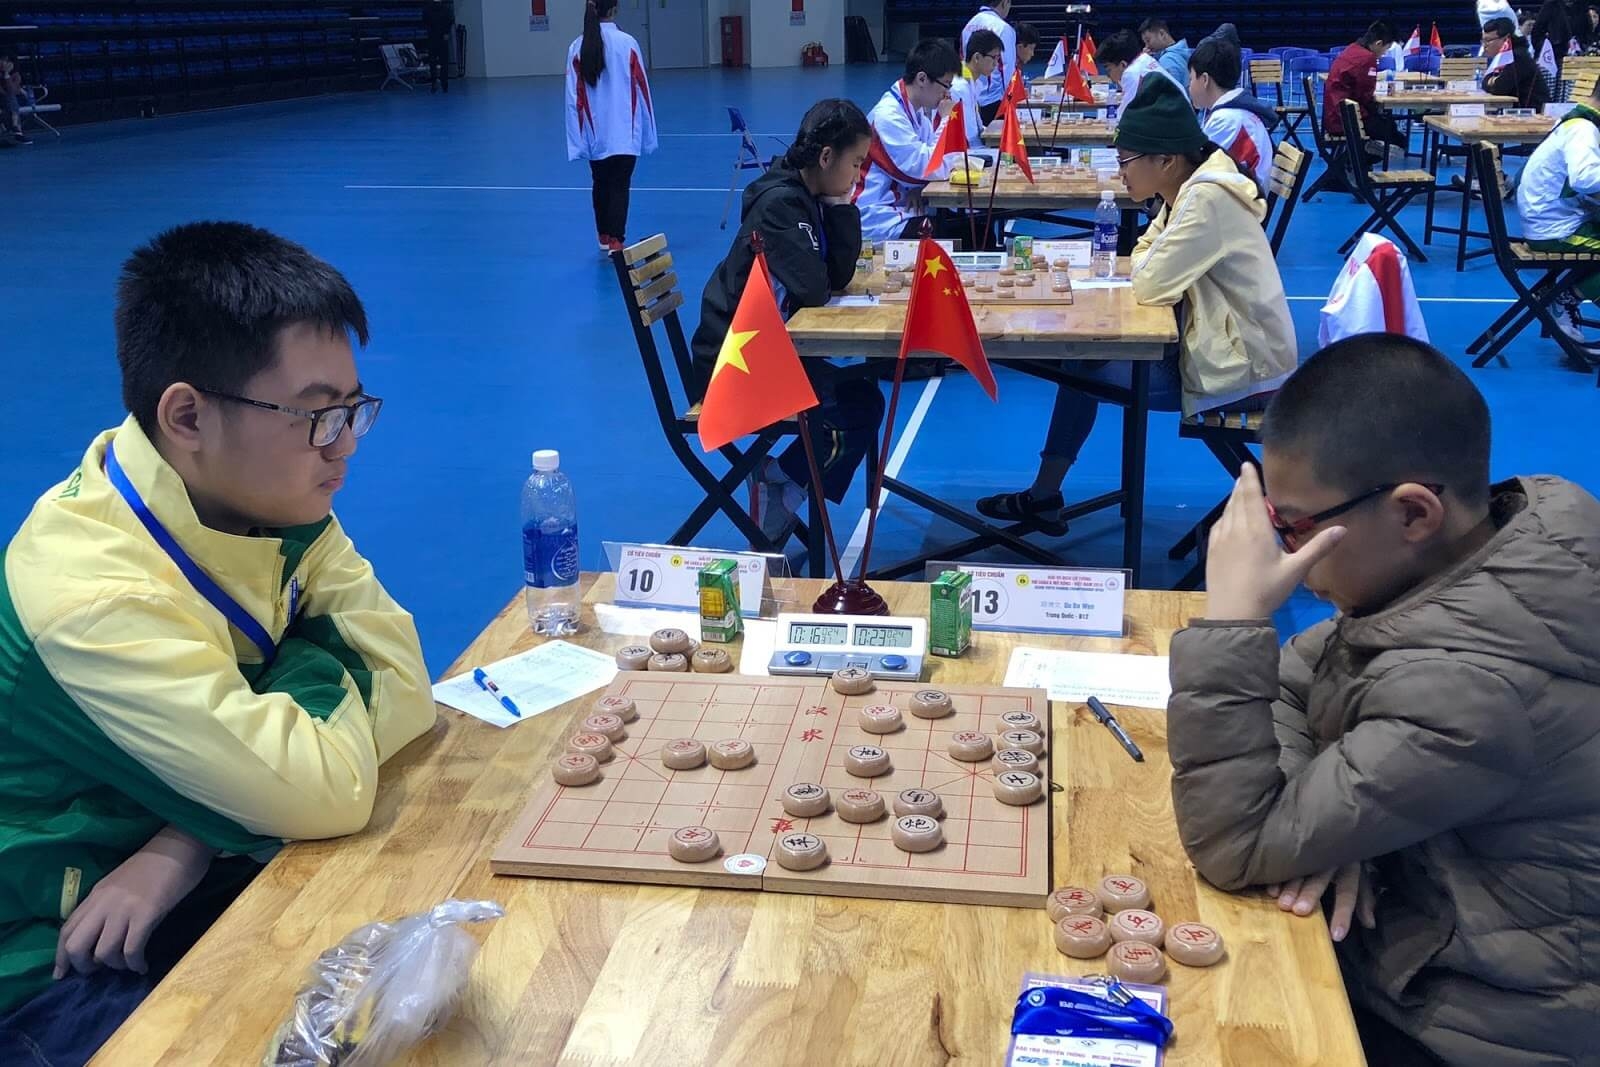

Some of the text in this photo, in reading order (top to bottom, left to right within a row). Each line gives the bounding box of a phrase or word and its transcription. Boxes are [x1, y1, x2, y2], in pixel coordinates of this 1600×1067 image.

[892, 250, 900, 260] 9
[629, 568, 654, 592] 10
[972, 589, 999, 614] 13
[794, 626, 820, 644] 0:16
[858, 629, 886, 647] 0:23
